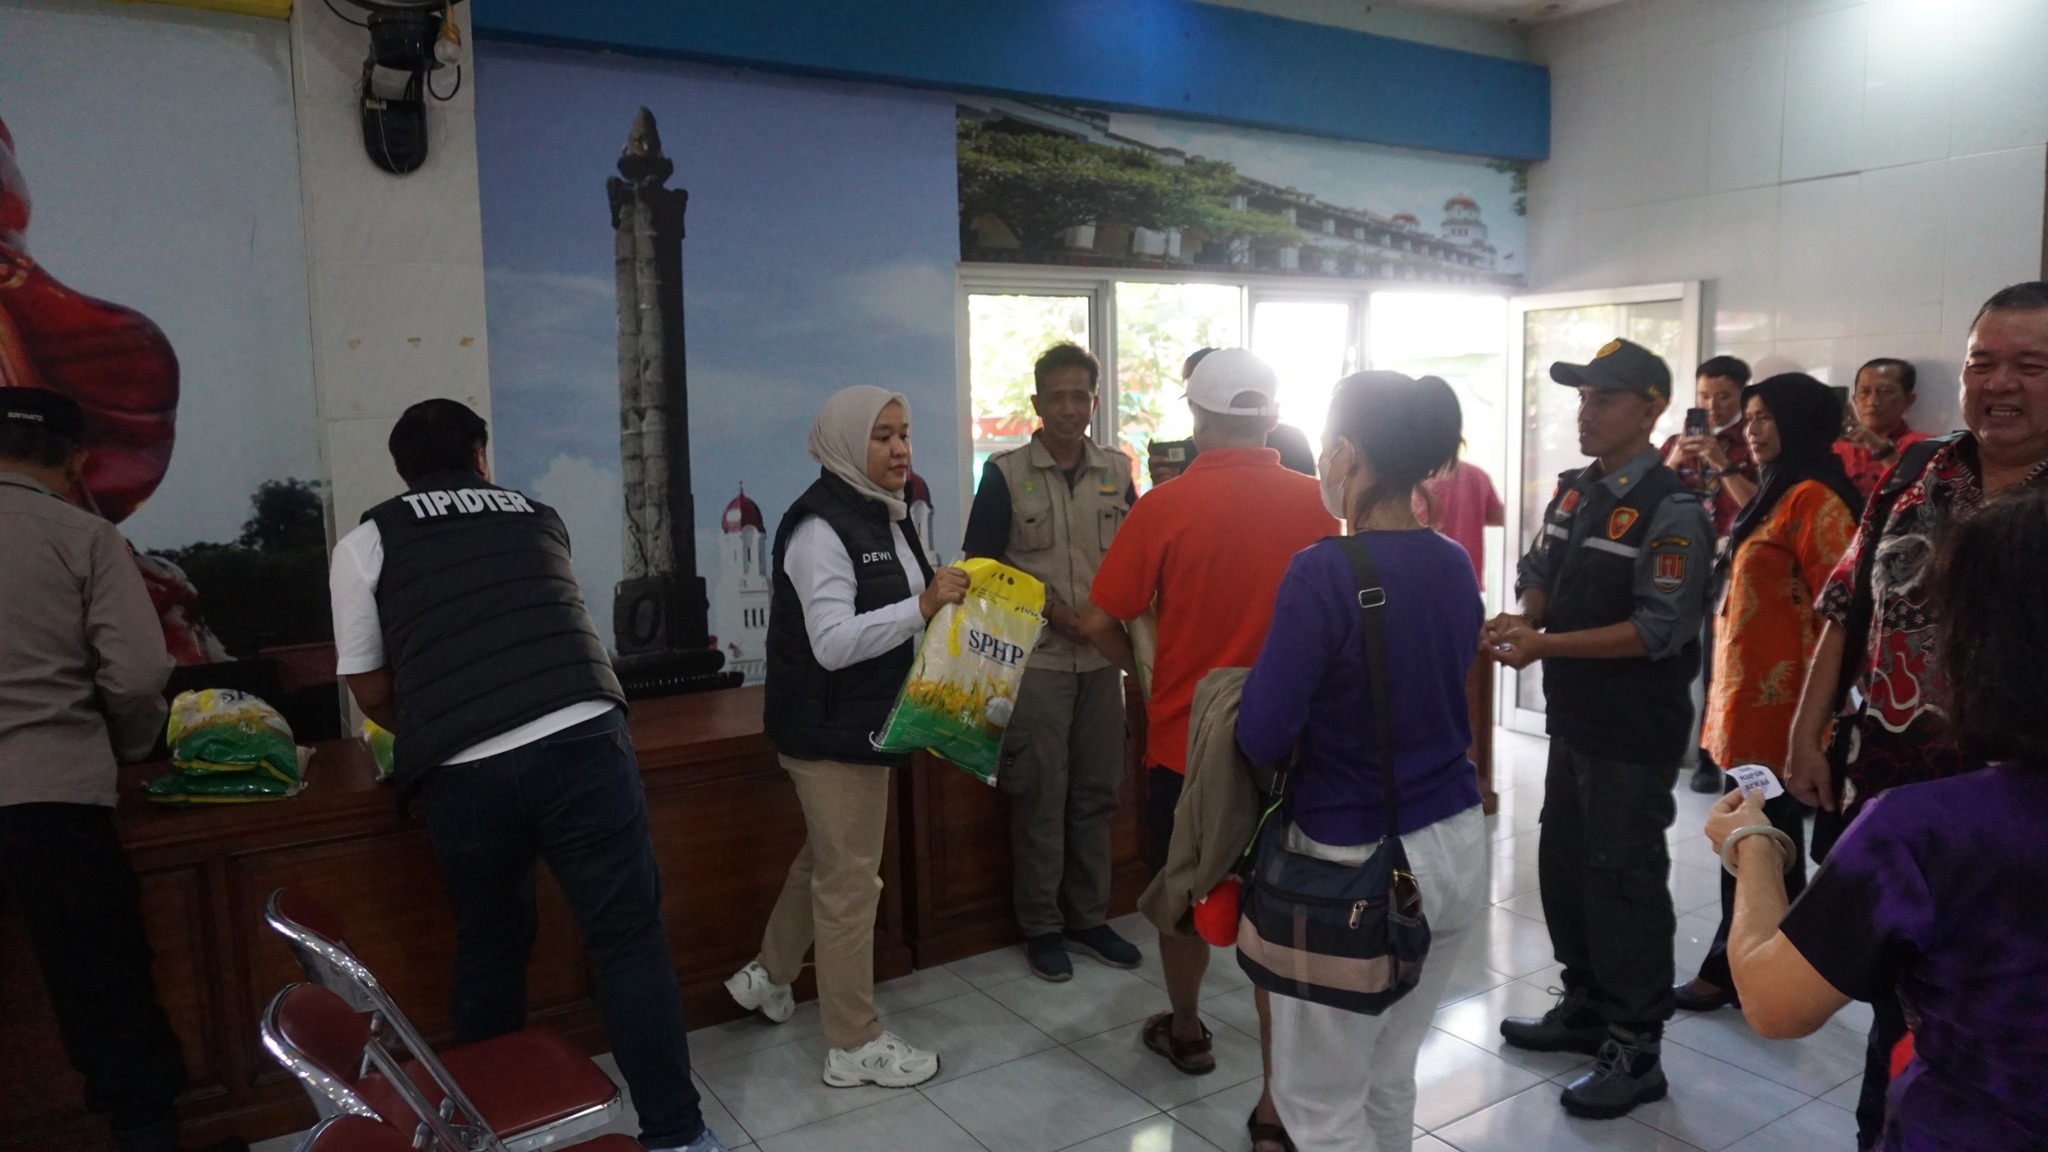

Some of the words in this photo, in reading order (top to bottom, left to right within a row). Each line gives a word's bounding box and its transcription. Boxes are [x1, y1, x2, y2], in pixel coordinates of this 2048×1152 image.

[401, 488, 535, 518] TIPIDTER
[862, 551, 892, 563] DEWI
[969, 629, 1024, 665] SPHP
